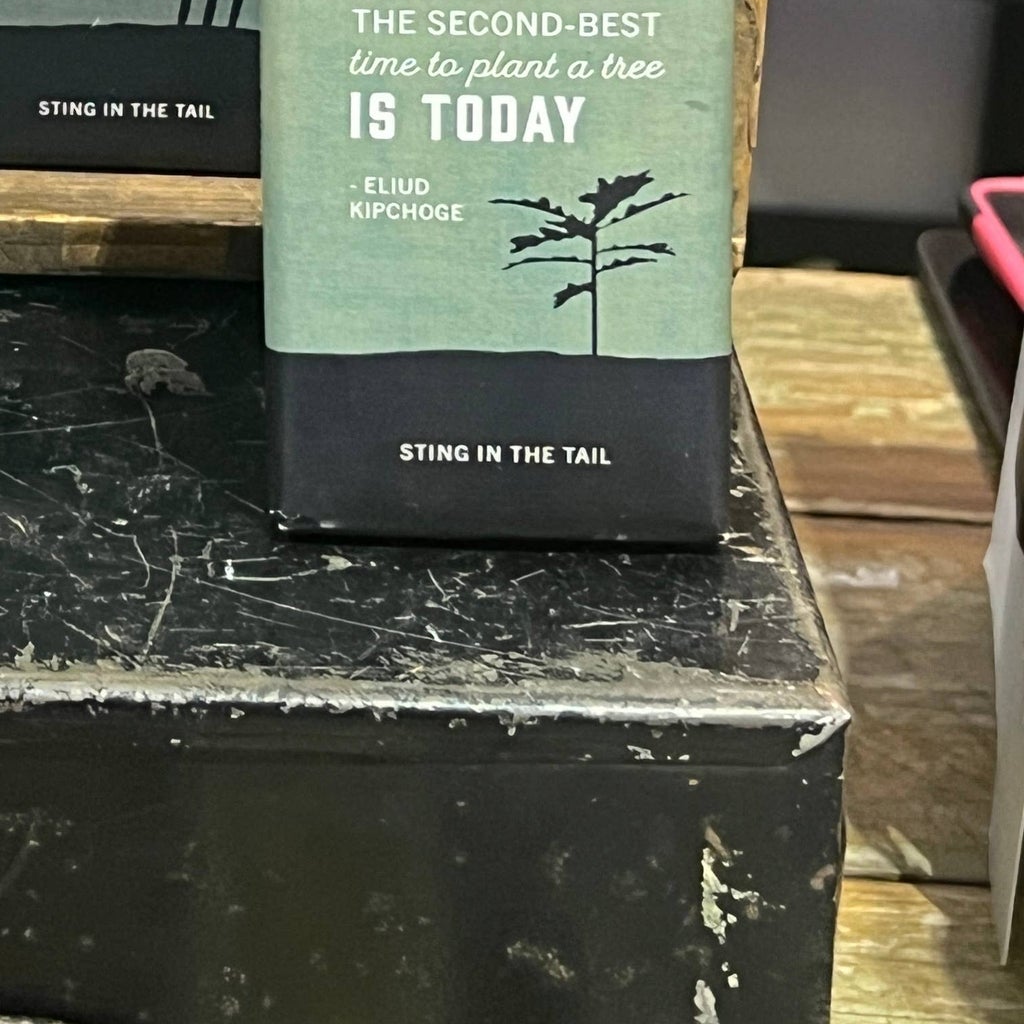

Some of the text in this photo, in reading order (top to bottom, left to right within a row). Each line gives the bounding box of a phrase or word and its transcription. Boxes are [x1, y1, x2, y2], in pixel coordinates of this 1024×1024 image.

[351, 8, 662, 38] THE SECOND-BEST
[349, 48, 666, 89] time to plant a tree
[38, 100, 215, 119] STING IN THE TAIL
[350, 91, 586, 144] IS TODAY
[364, 176, 430, 196] ELIUD
[350, 201, 464, 222] KIPCHOGE
[399, 443, 612, 465] STING IN THE TAIL
